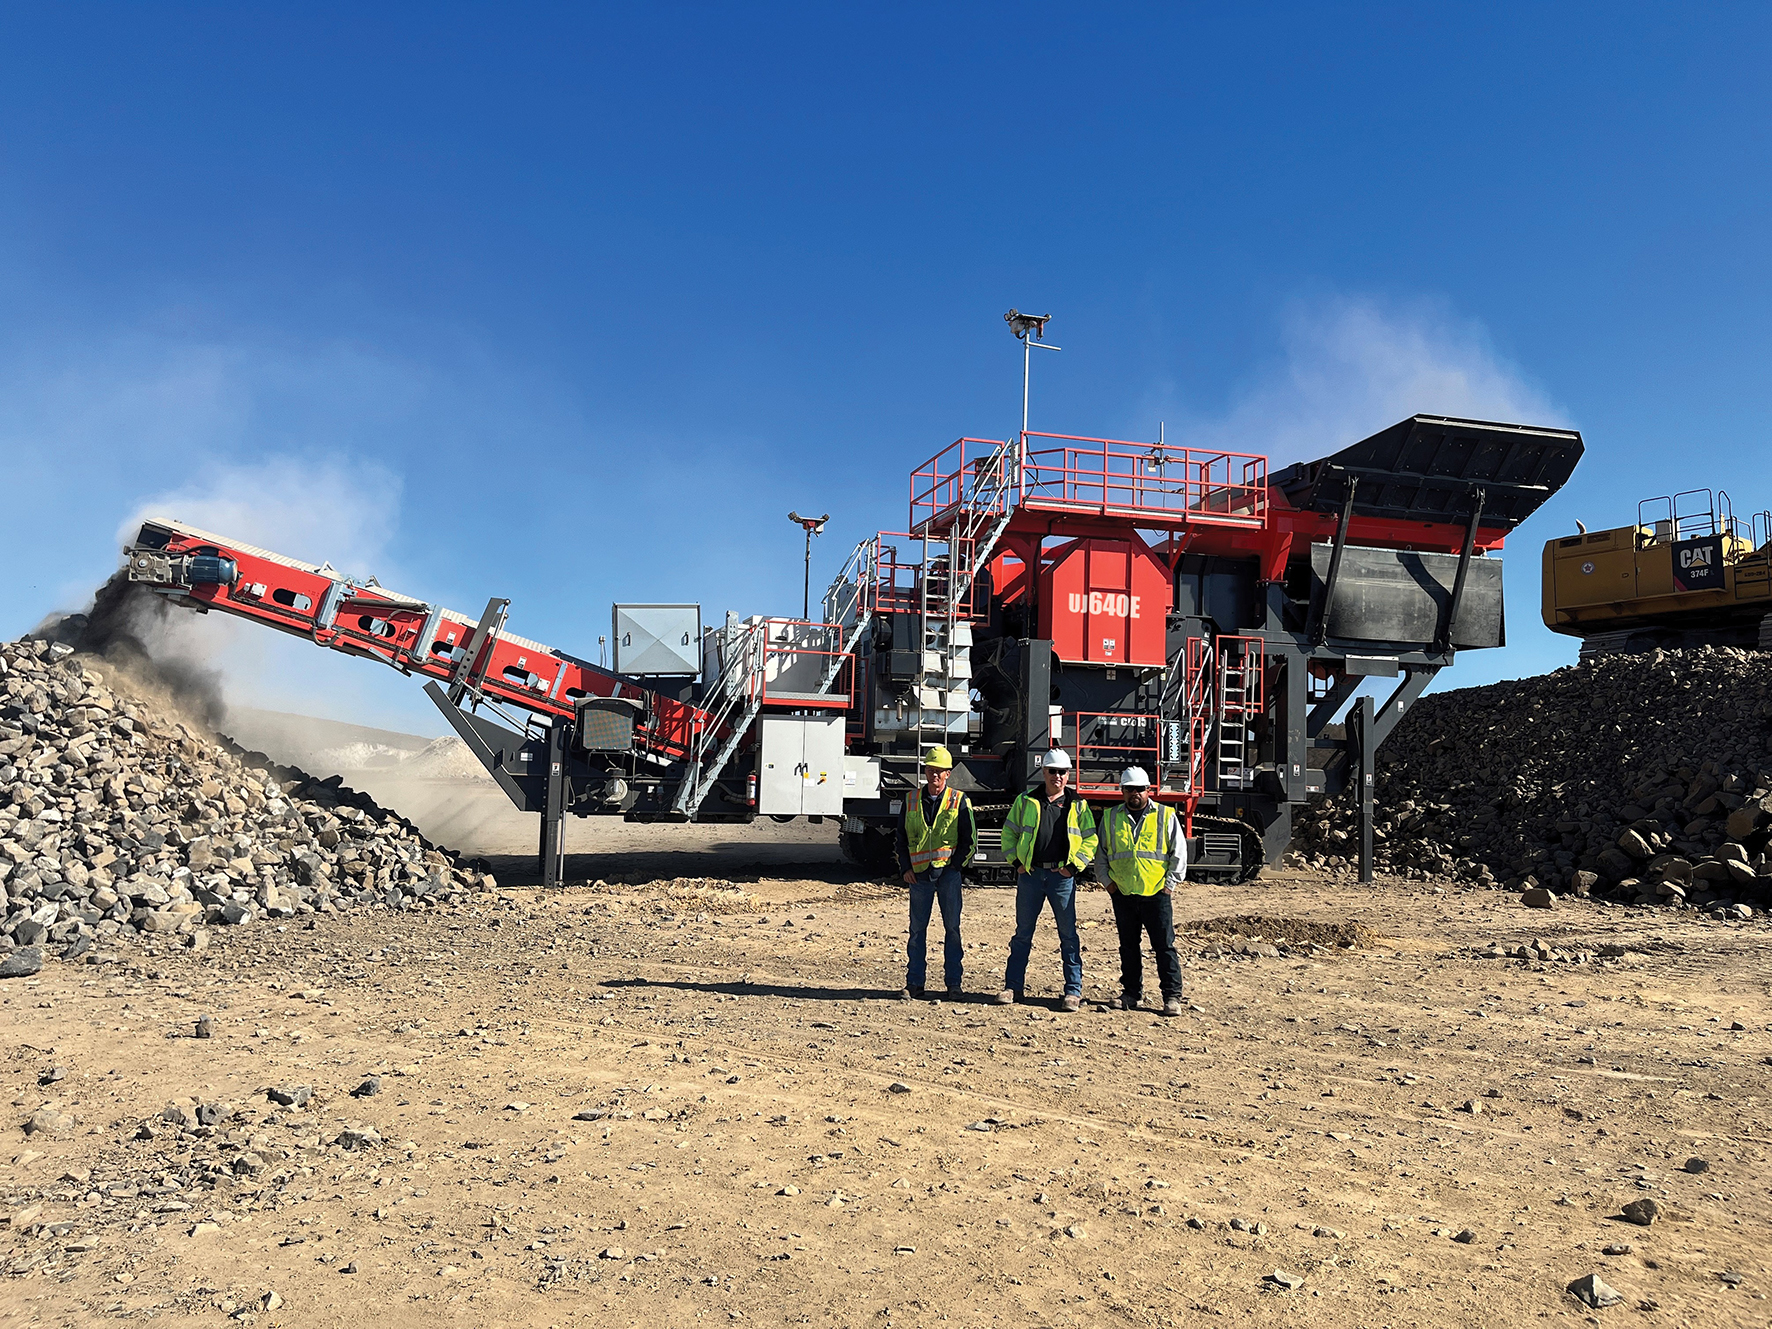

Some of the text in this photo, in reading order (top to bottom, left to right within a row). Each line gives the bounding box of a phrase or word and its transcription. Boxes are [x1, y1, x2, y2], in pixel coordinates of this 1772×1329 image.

[1680, 546, 1713, 568] CAT
[1690, 569, 1709, 578] 374F
[1069, 591, 1140, 618] UJ640E
